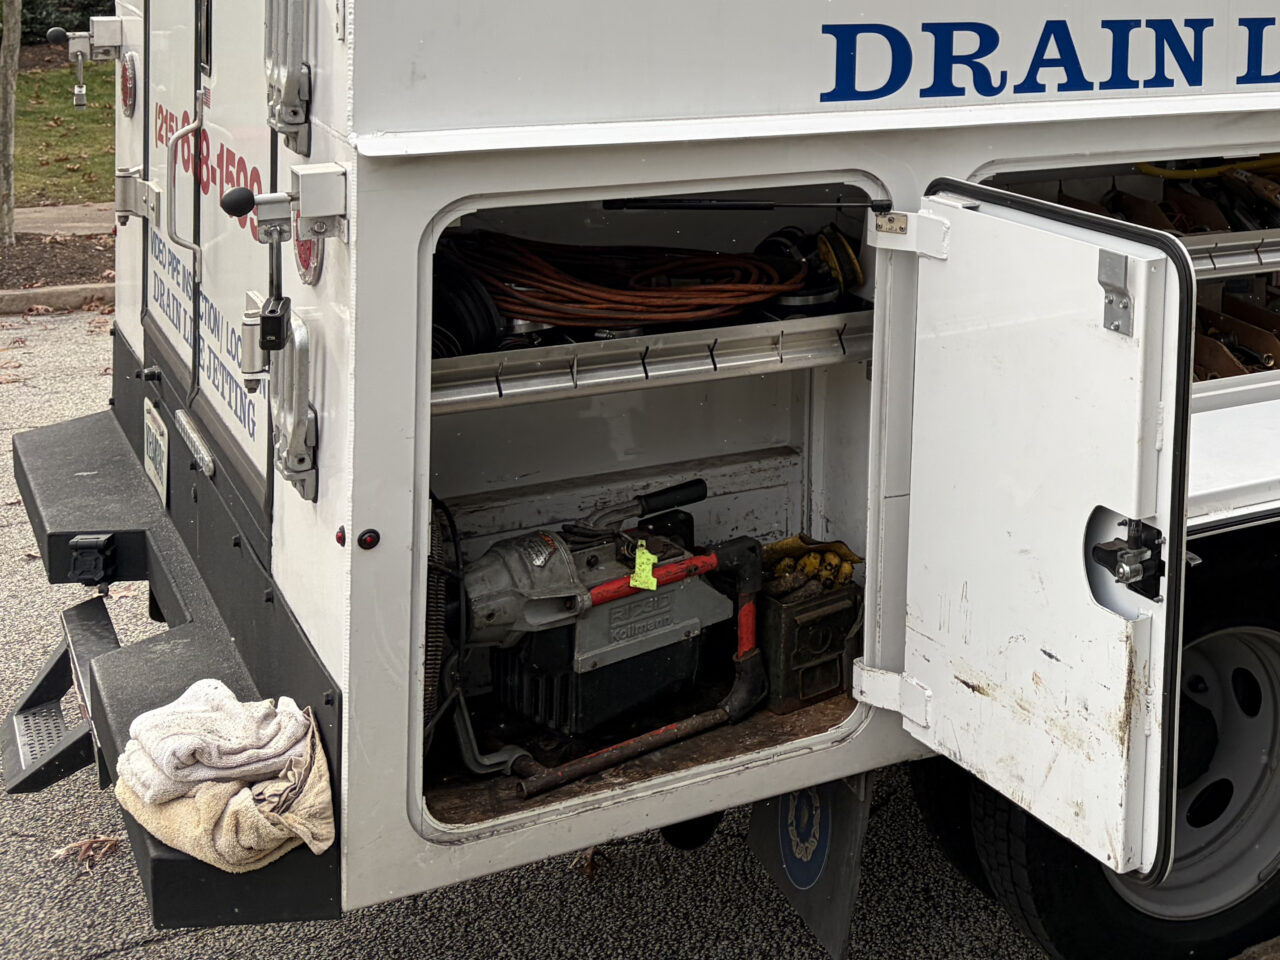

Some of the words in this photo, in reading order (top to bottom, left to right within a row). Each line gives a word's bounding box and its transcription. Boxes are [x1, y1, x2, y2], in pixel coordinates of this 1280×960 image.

[819, 18, 1214, 103] DRAIN
[181, 109, 263, 241] 68-1599
[151, 228, 167, 271] VIDEO
[168, 246, 181, 287] PIPE
[182, 263, 220, 343] INSCTION
[153, 270, 182, 332] DRAIN
[183, 305, 205, 374] LIE
[206, 345, 257, 443] JETTING
